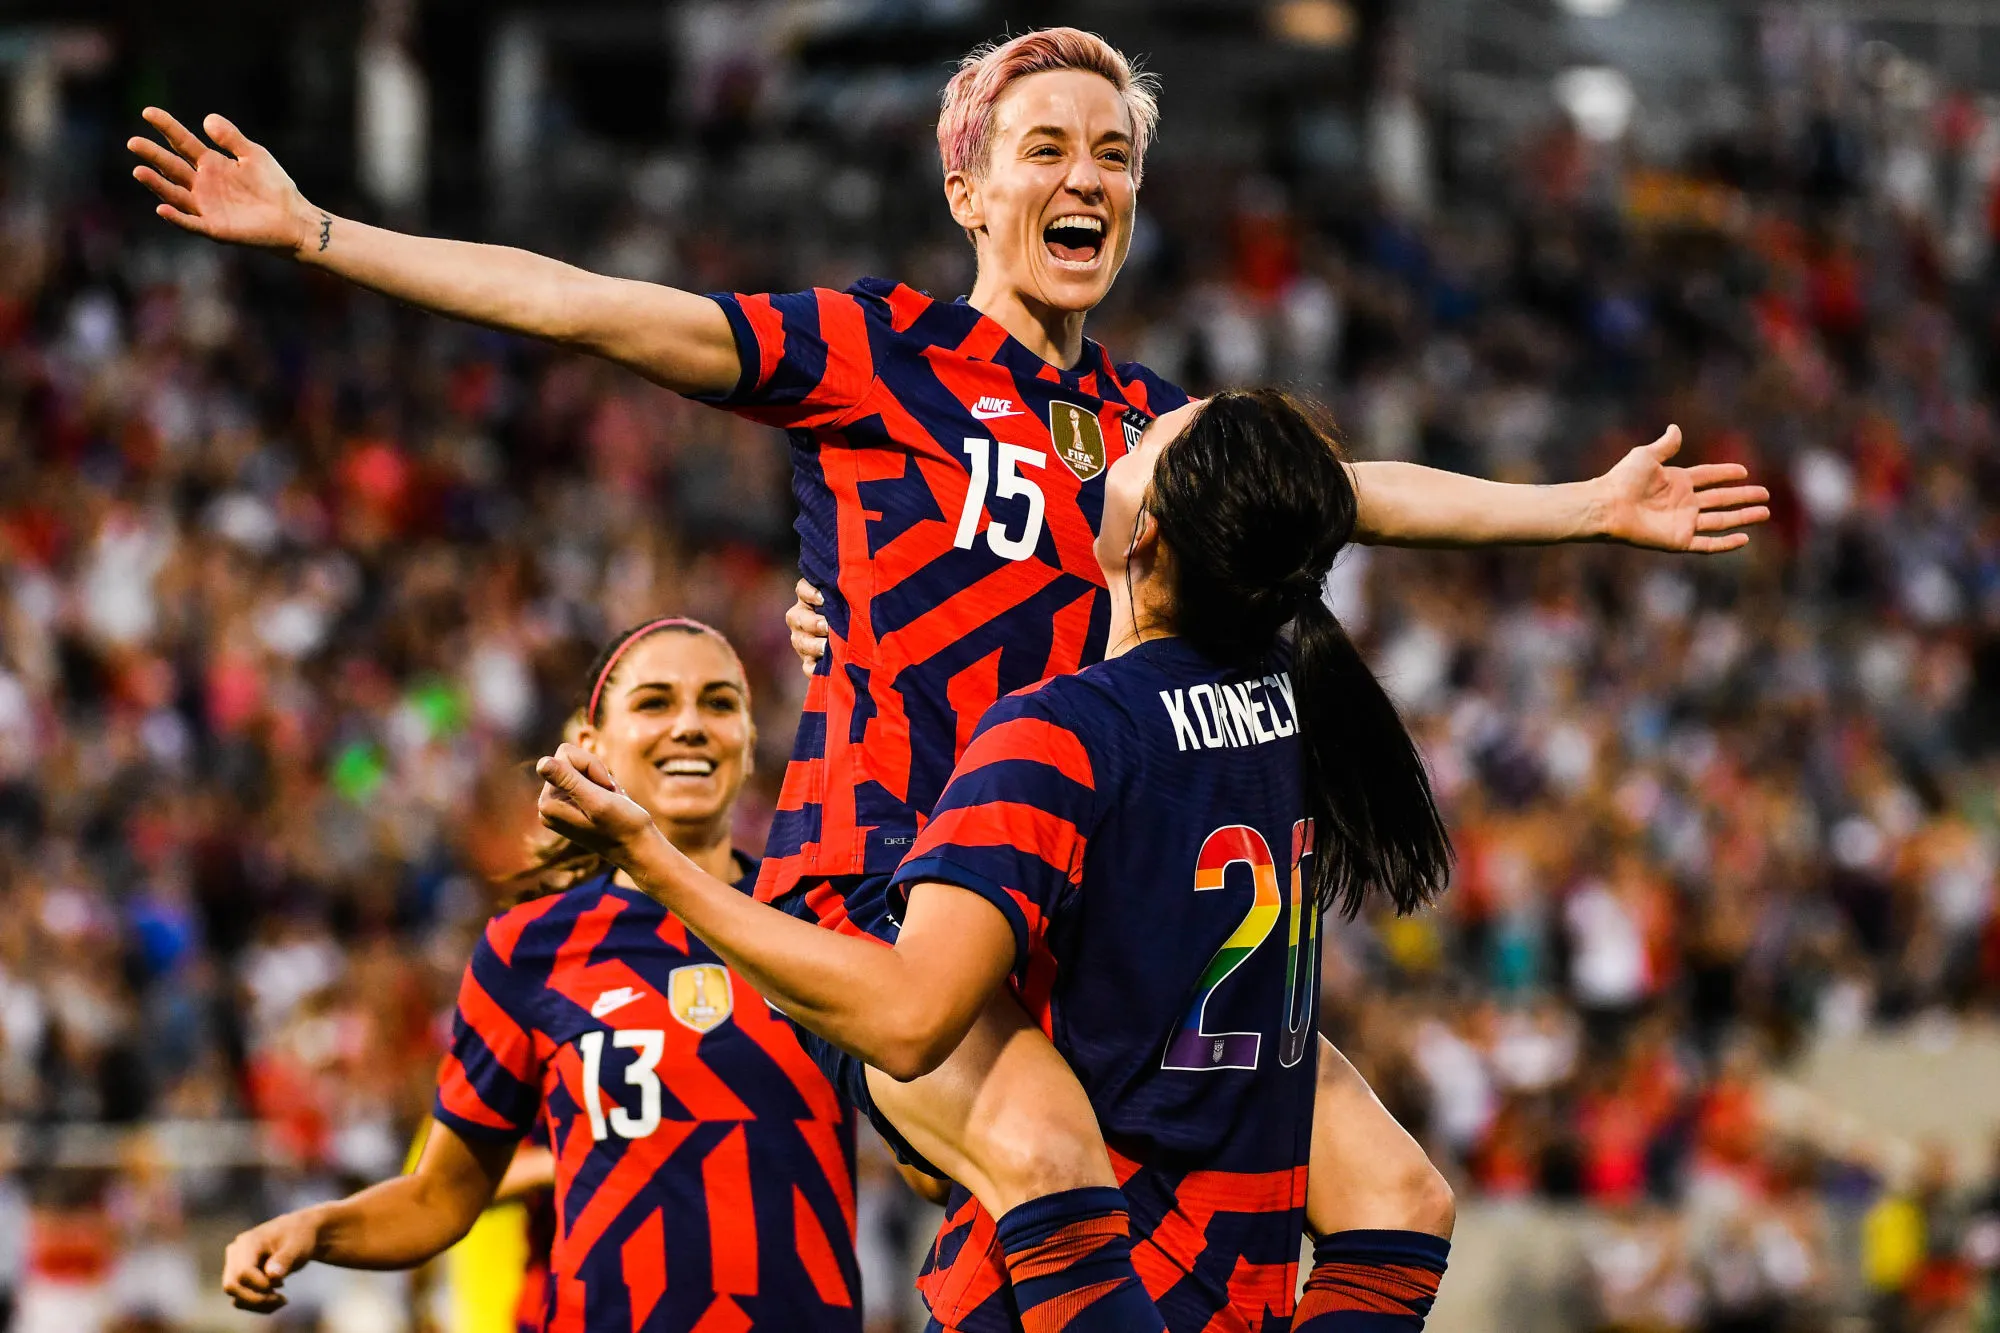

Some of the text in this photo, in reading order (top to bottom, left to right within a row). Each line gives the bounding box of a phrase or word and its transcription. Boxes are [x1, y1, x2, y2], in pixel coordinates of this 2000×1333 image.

[977, 396, 1012, 412] NIKE
[1067, 447, 1092, 465] FIFA
[954, 437, 1047, 561] 15
[1161, 817, 1318, 1070] 20
[580, 1029, 665, 1141] 13
